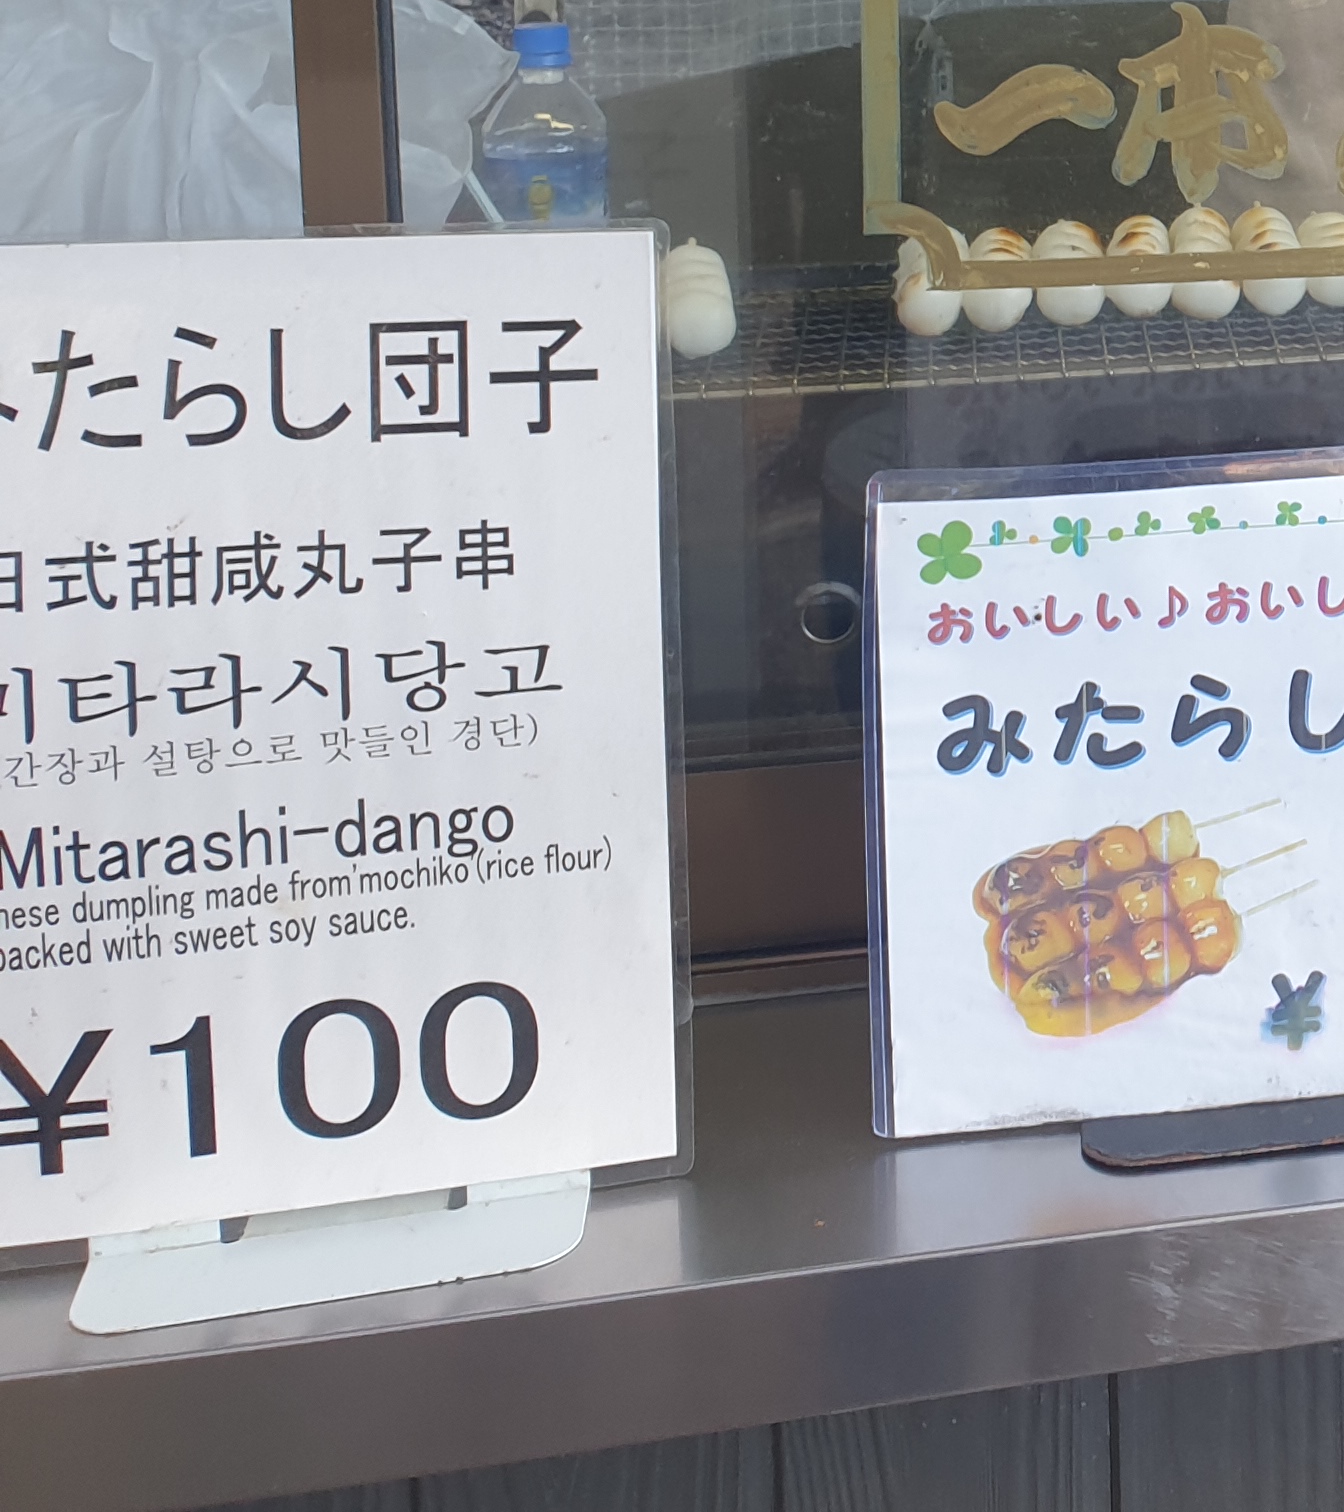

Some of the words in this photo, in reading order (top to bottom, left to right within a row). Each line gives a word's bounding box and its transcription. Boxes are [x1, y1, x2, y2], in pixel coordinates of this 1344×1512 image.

[0, 317, 600, 453] たらし団子
[3, 744, 126, 788] 간장과
[143, 733, 303, 778] 설탕으로
[320, 719, 432, 766] 맛들인
[453, 711, 540, 754] 경단)
[0, 798, 516, 890] Mitarashi-dango
[72, 884, 196, 926] dumpling
[205, 874, 279, 911] made
[544, 834, 613, 874] flour)
[102, 923, 162, 963] with
[174, 915, 259, 955] sweet
[269, 917, 318, 947] soy
[329, 904, 416, 937] sauce.
[0, 980, 540, 1177] ¥100
